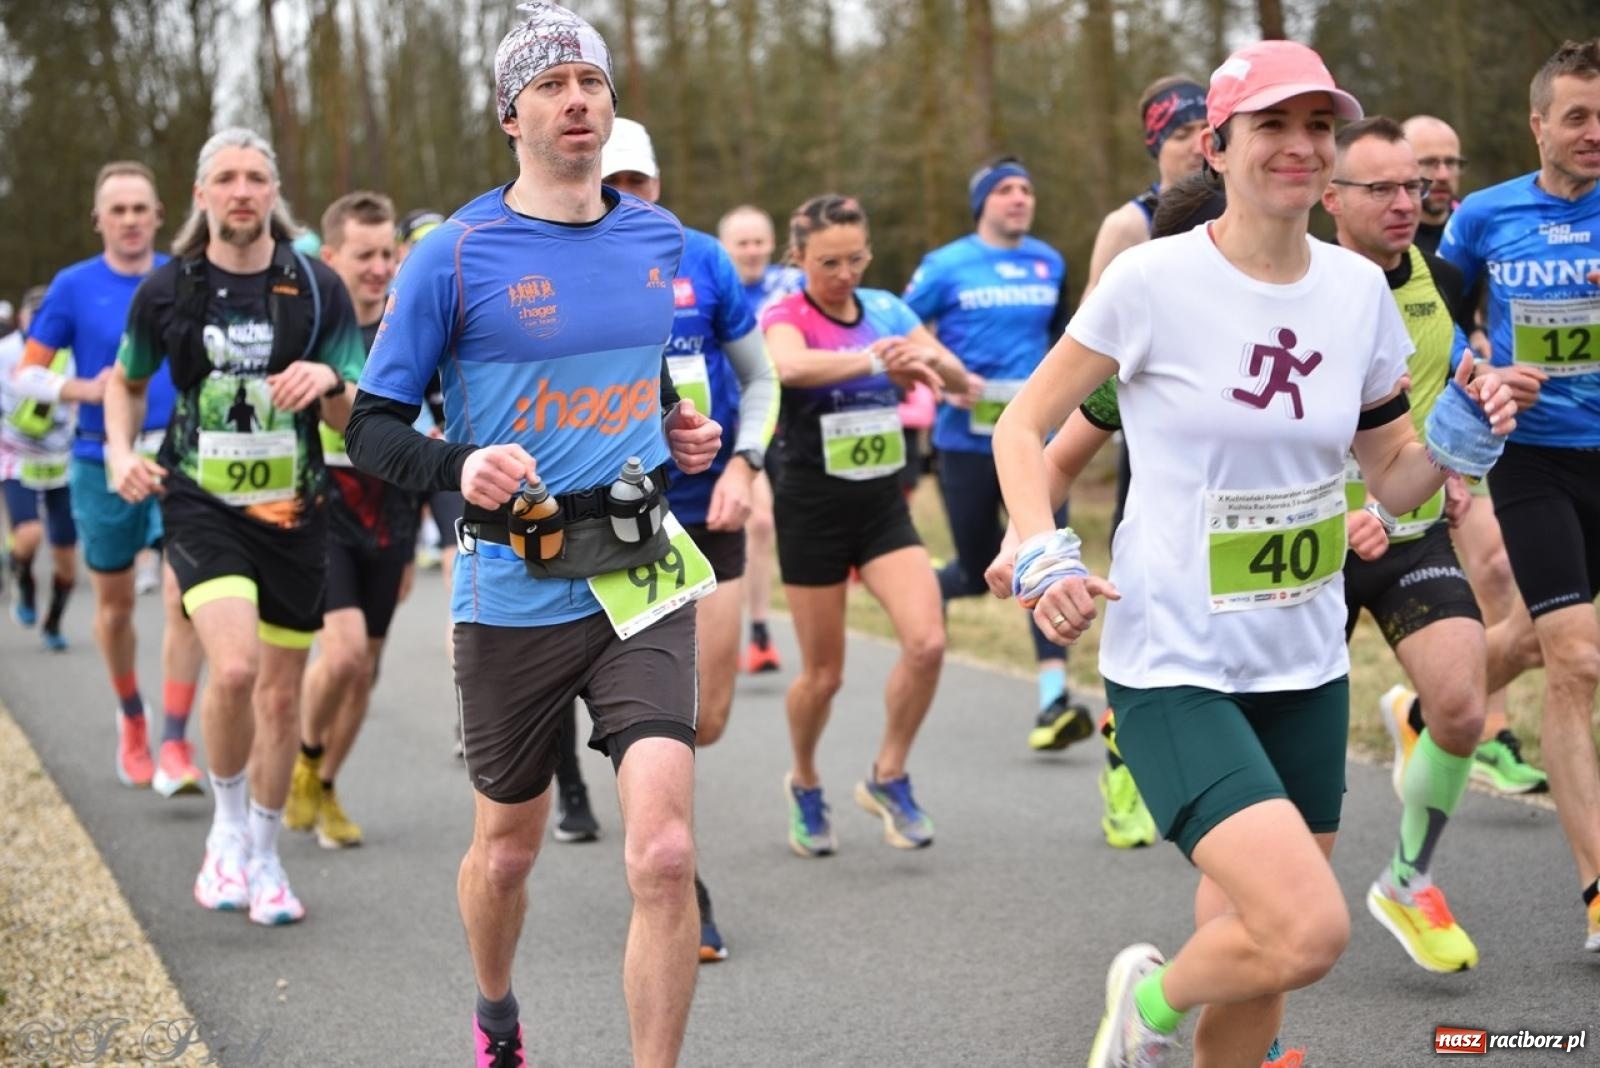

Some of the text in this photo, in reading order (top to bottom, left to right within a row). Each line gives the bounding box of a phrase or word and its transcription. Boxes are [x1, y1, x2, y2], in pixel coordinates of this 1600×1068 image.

[1541, 328, 1591, 362] 12
[850, 434, 886, 466] 69
[226, 460, 271, 491] 90
[1248, 528, 1320, 584] 40
[626, 542, 686, 605] 99
